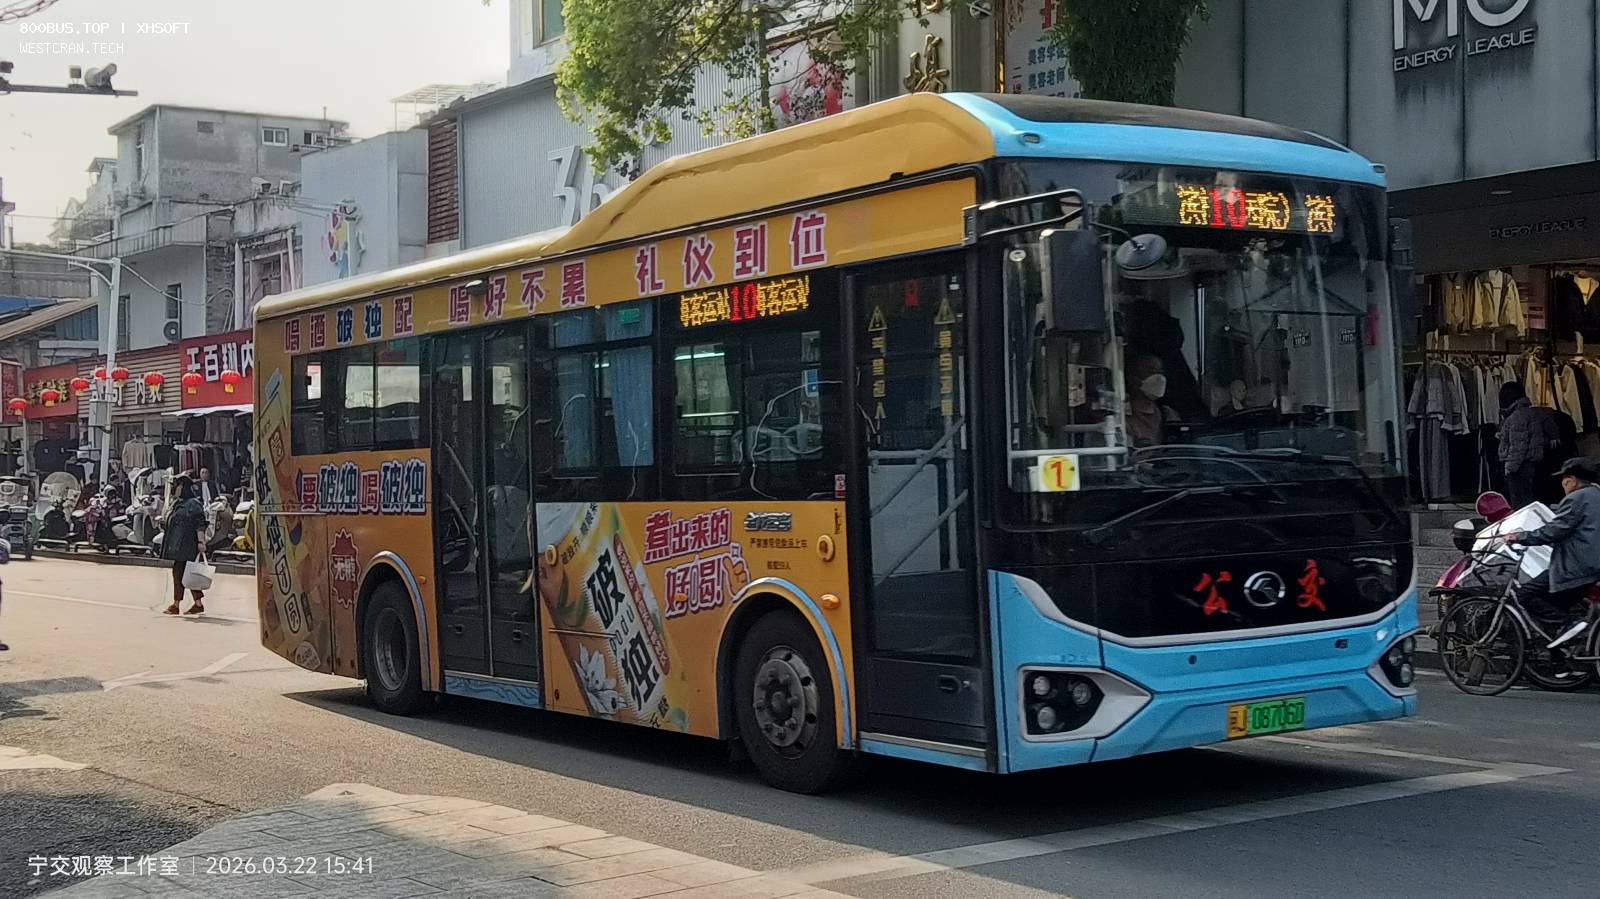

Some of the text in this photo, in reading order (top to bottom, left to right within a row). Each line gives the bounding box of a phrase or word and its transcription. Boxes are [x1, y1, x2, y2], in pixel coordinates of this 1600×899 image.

[1393, 28, 1536, 72] ENERGY LEAGUE
[284, 211, 828, 353] 喝酒破独配 喝好不累 礼仪到位
[301, 458, 426, 514] 要破独喝破独
[1051, 461, 1066, 489] 1
[643, 508, 732, 565] 煮出来的
[1193, 559, 1327, 616] 公 交
